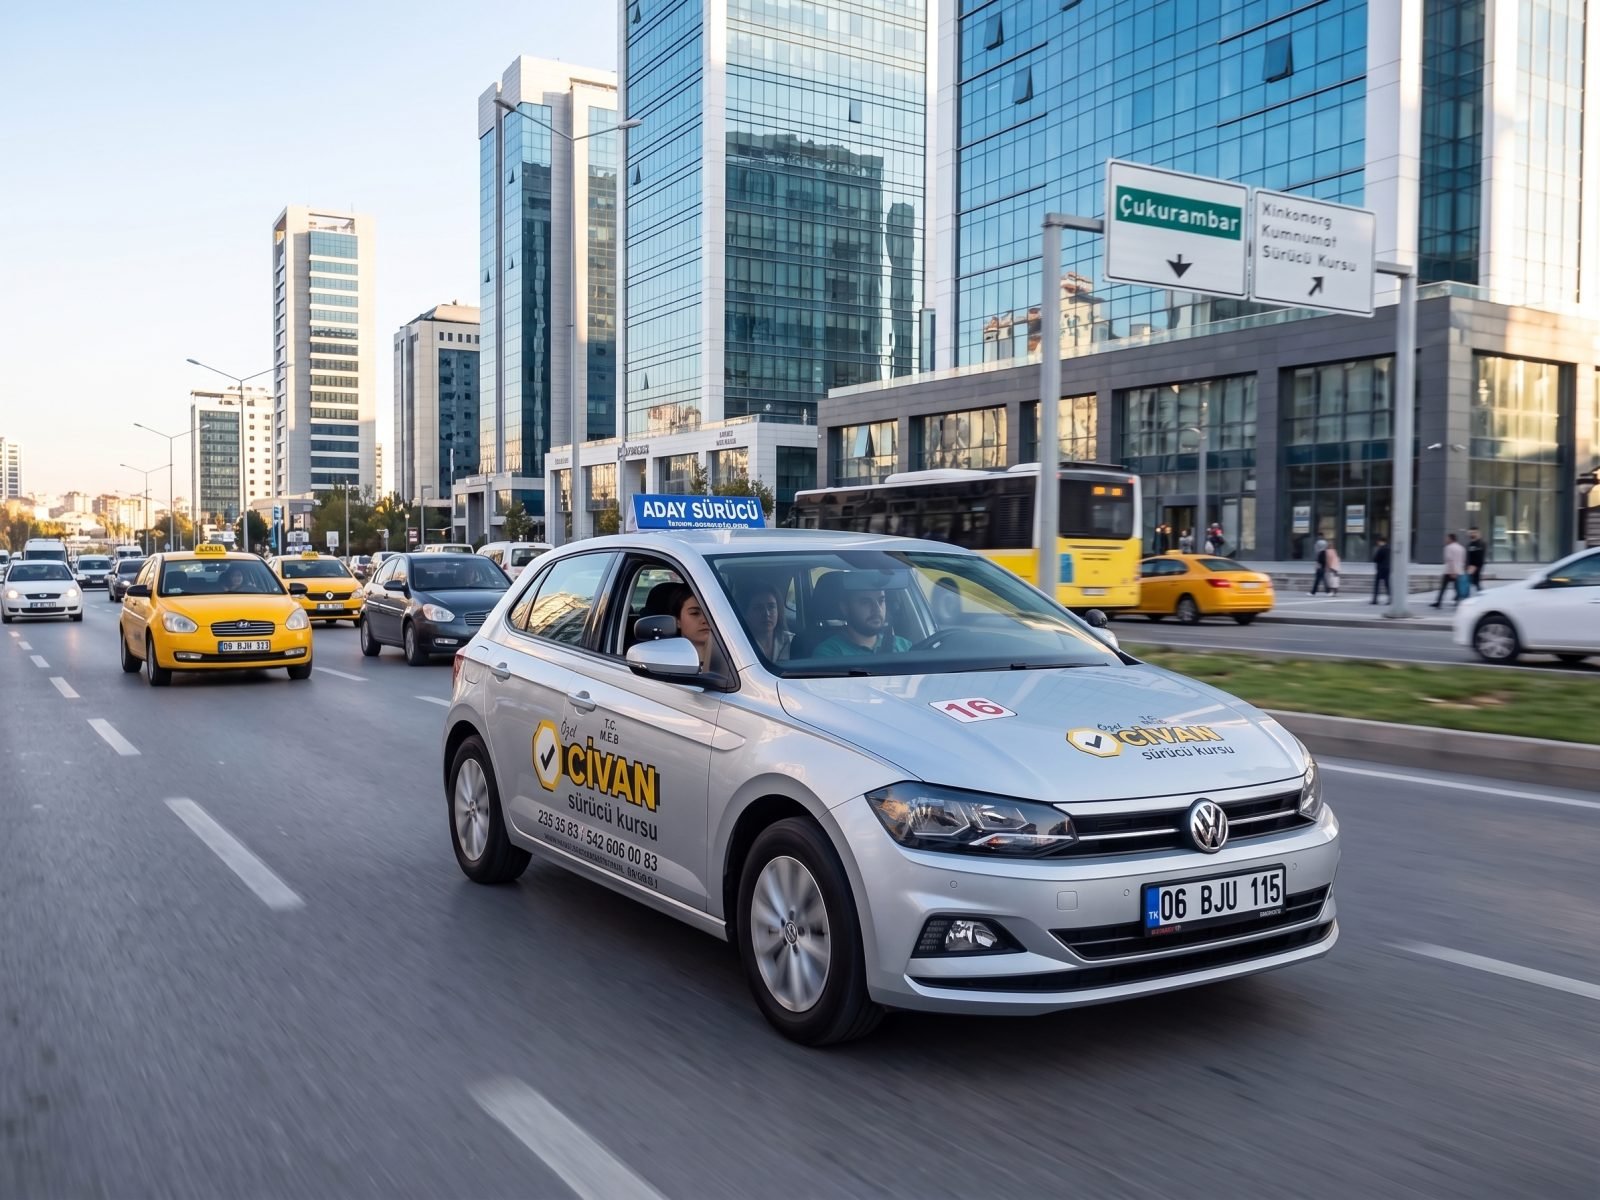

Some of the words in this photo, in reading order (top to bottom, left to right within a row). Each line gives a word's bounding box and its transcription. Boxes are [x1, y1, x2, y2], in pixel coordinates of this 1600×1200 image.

[1119, 194, 1239, 232] Çukurambar
[1262, 244, 1312, 265] Sürücü
[1317, 254, 1357, 272] Kursu
[643, 501, 687, 518] ADAY
[691, 498, 759, 520] SÜRÜCÜ
[944, 700, 1005, 719] 16
[560, 719, 577, 741] Özel
[1118, 725, 1225, 747] CİVAN
[1142, 746, 1194, 761] sürücü
[1196, 744, 1235, 756] kursu
[566, 736, 658, 812] CİVAN
[568, 792, 612, 825] sürücü
[616, 806, 658, 842] kursu
[538, 809, 553, 828] 235
[554, 816, 565, 834] 35
[567, 821, 579, 840] 83
[586, 829, 604, 850] 542
[606, 838, 625, 859] 606
[628, 845, 641, 865] 00
[644, 852, 658, 872] 83
[1160, 888, 1187, 921] 06
[1201, 880, 1237, 915] BJU
[1250, 873, 1280, 906] 115
